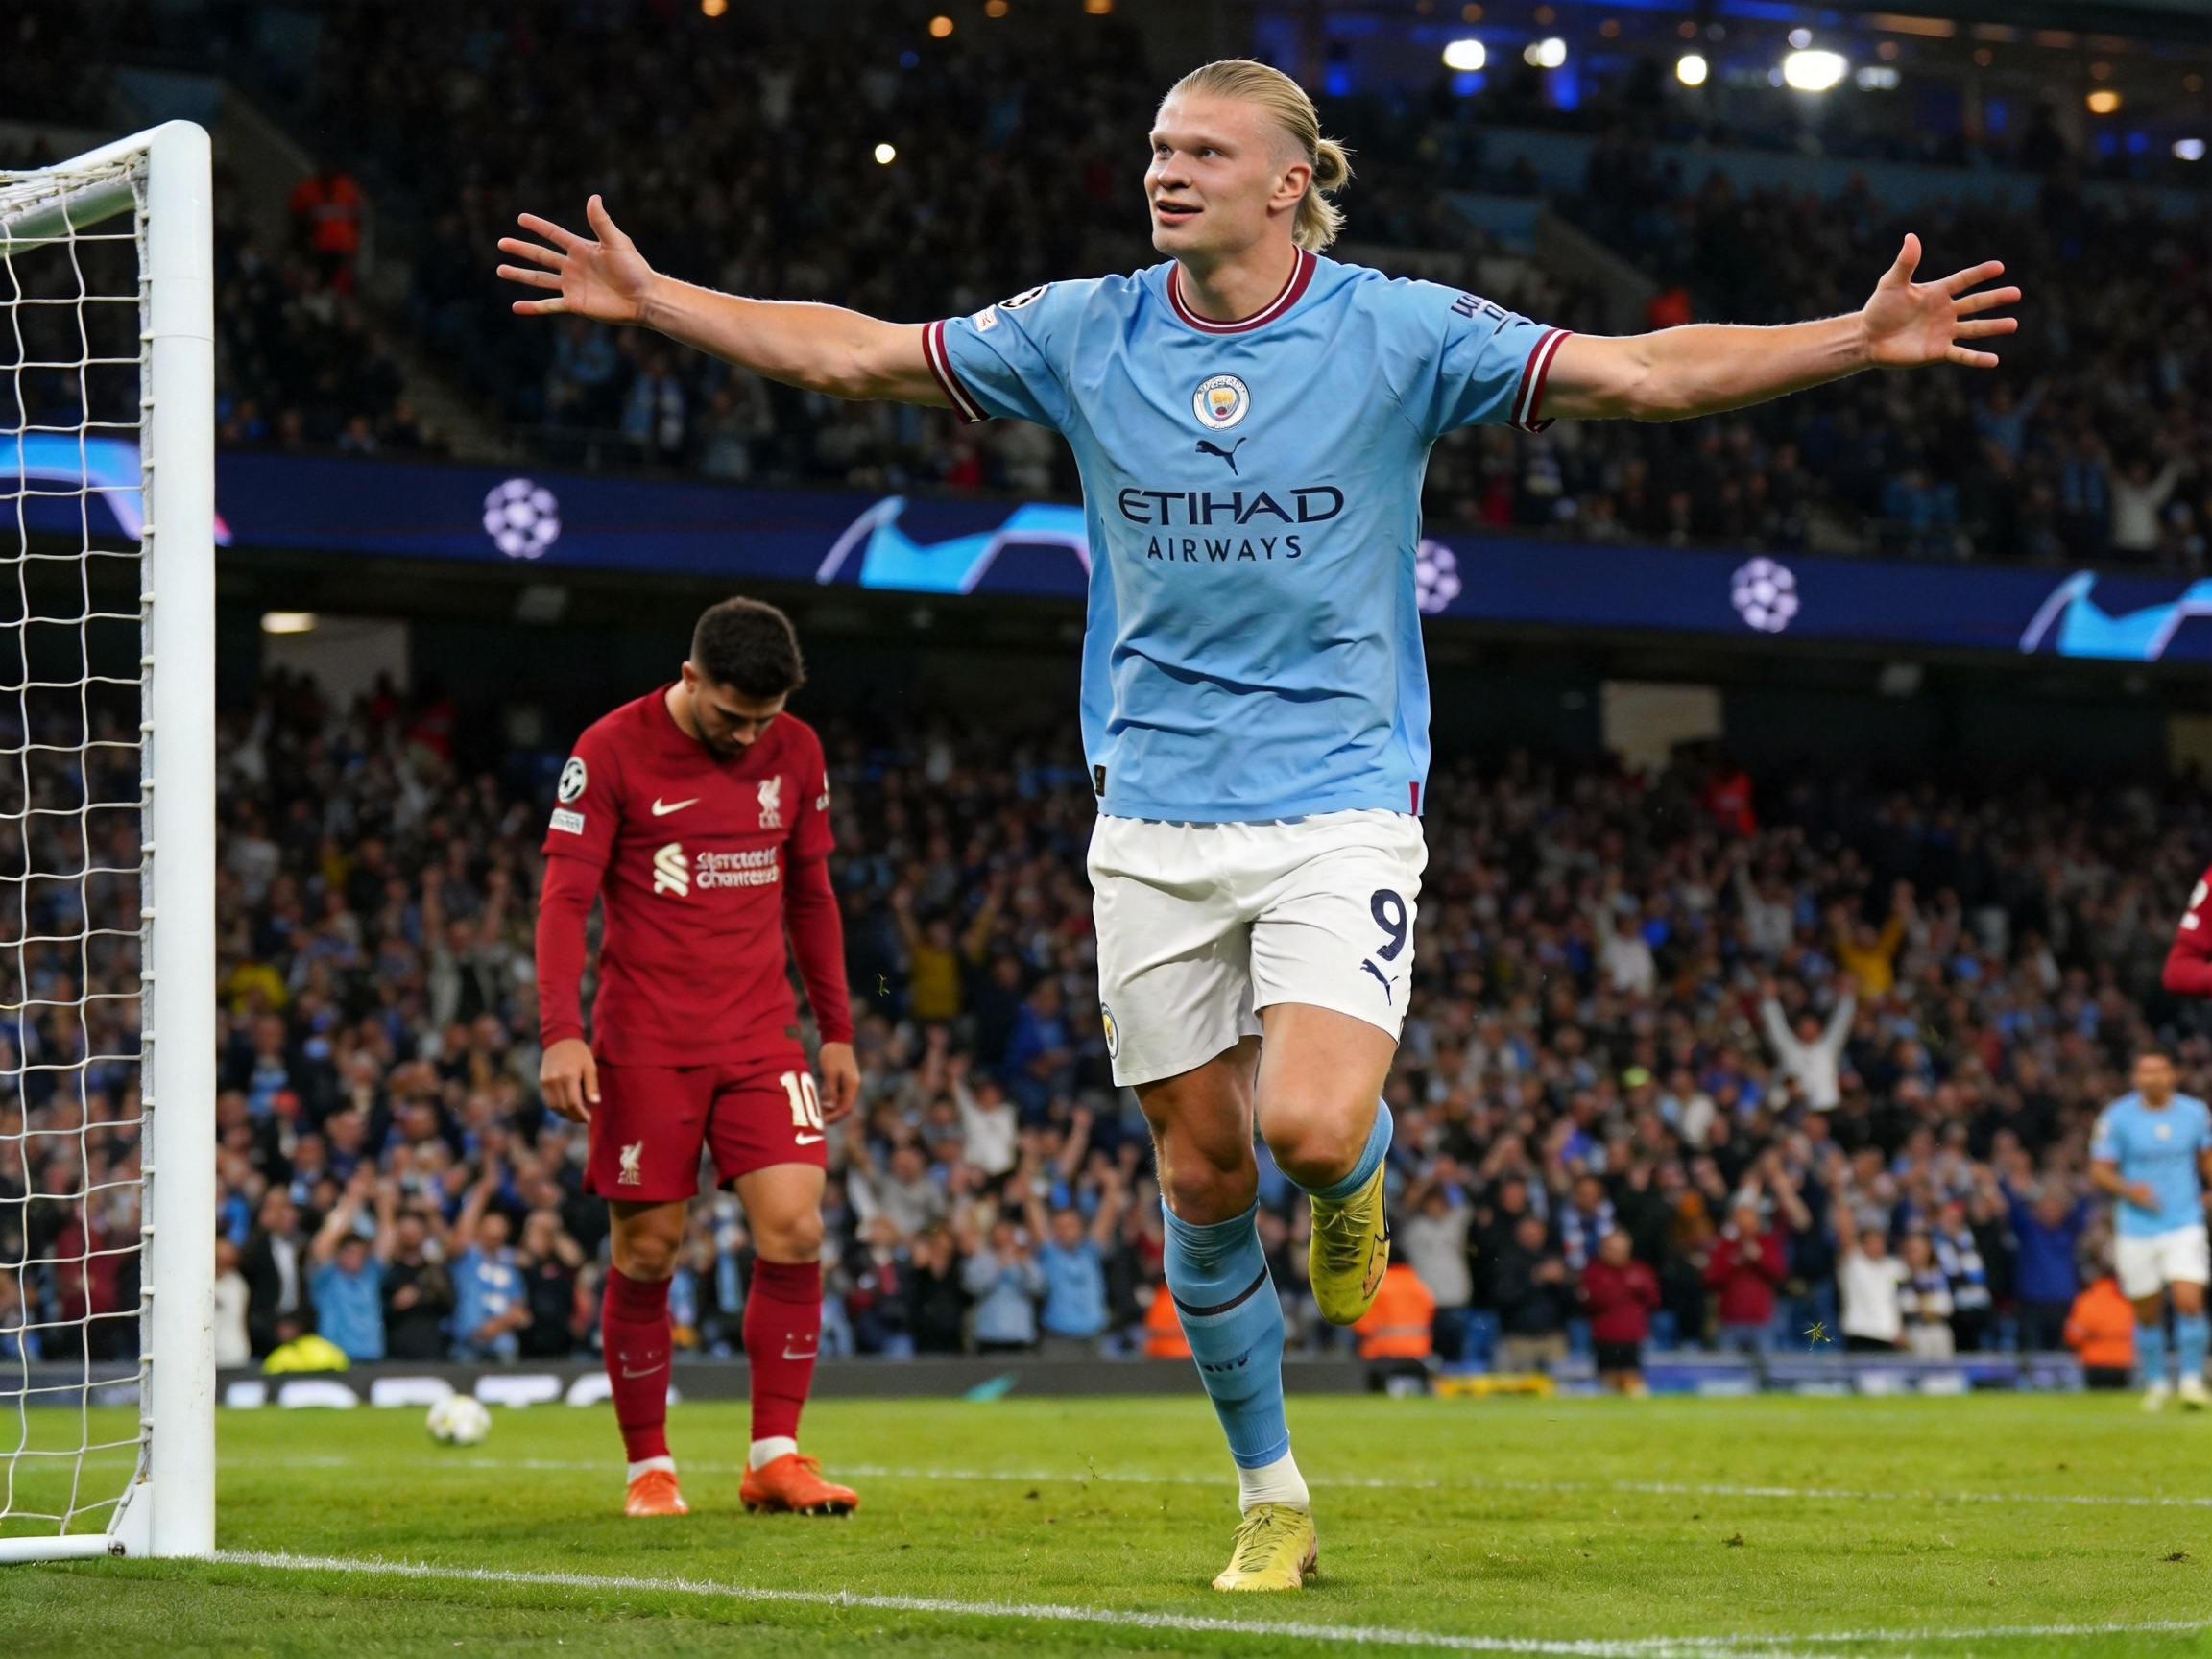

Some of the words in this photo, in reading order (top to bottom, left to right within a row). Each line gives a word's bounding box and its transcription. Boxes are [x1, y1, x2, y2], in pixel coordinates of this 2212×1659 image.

[1118, 486, 1344, 526] ETIHAD
[1147, 534, 1303, 563] AIRWAYS
[1370, 888, 1407, 962] 9
[779, 1070, 826, 1131] 10
